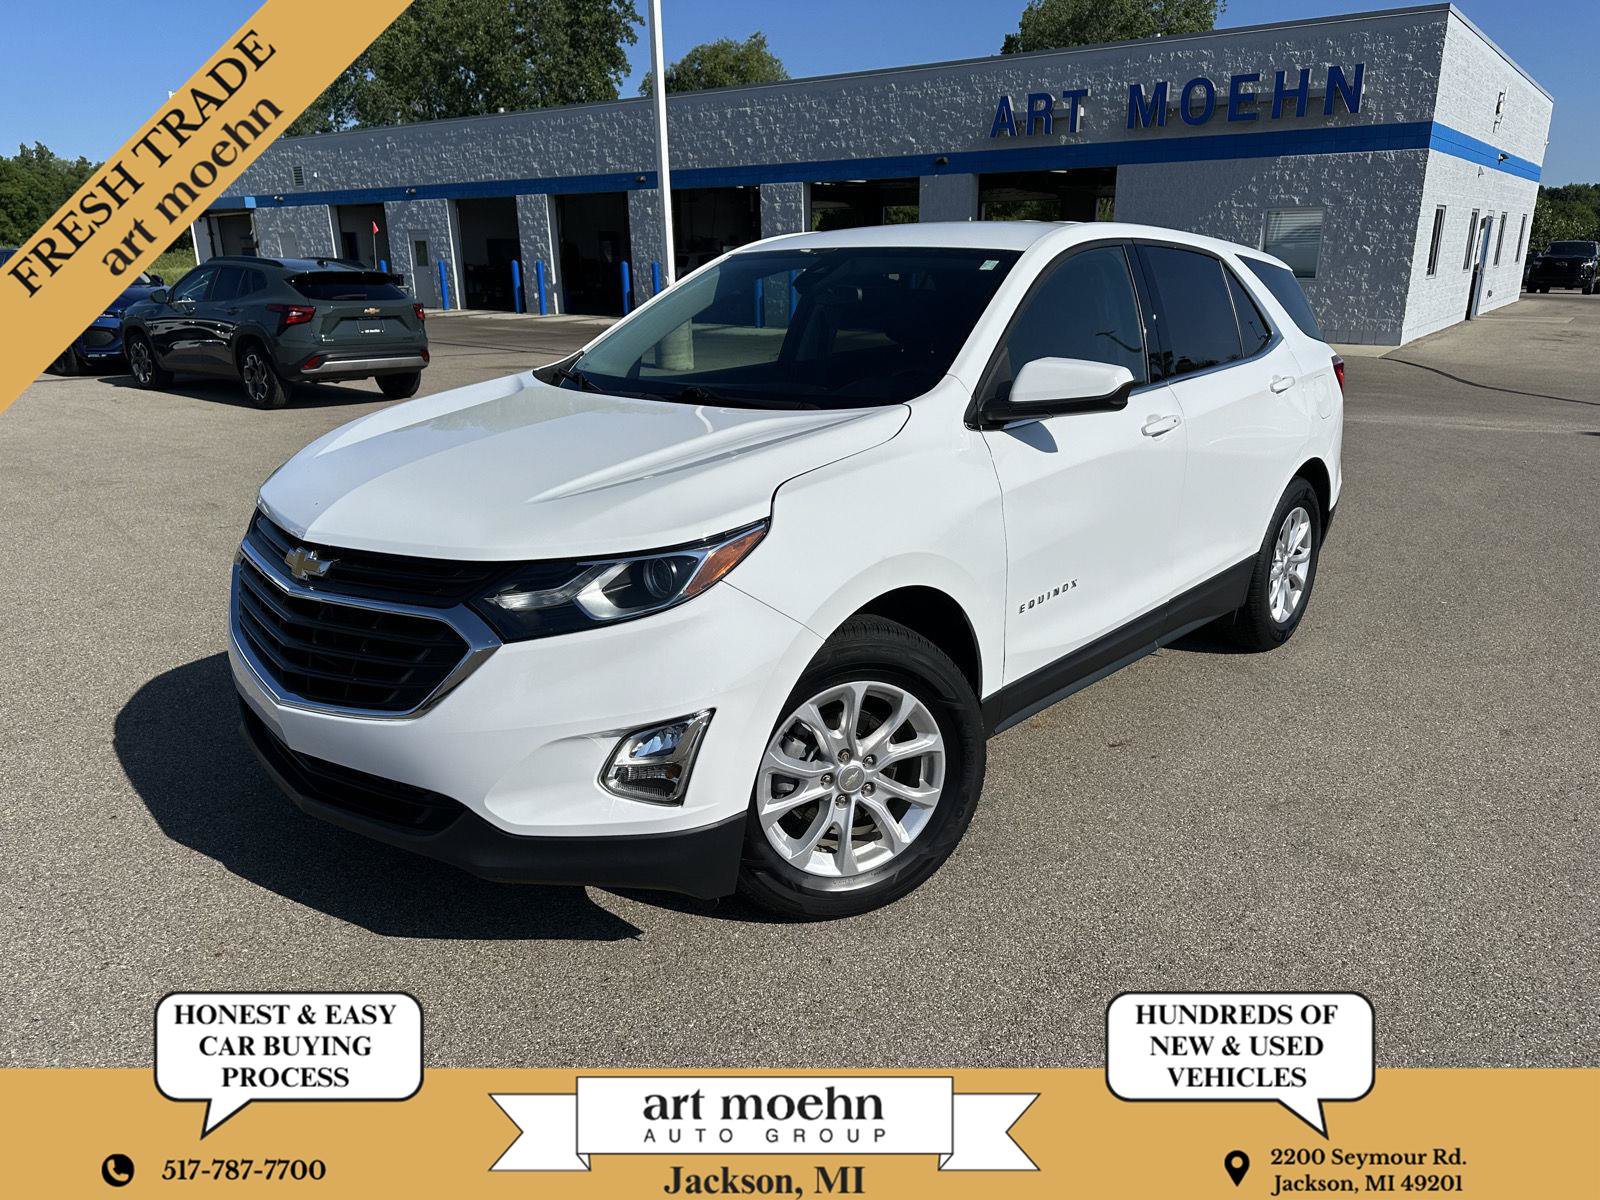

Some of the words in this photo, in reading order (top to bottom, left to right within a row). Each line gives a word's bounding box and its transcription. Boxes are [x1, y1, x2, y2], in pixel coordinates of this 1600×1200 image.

[990, 88, 1092, 138] ART
[1127, 63, 1367, 129] MOEHN
[1018, 578, 1078, 614] EQUINOX
